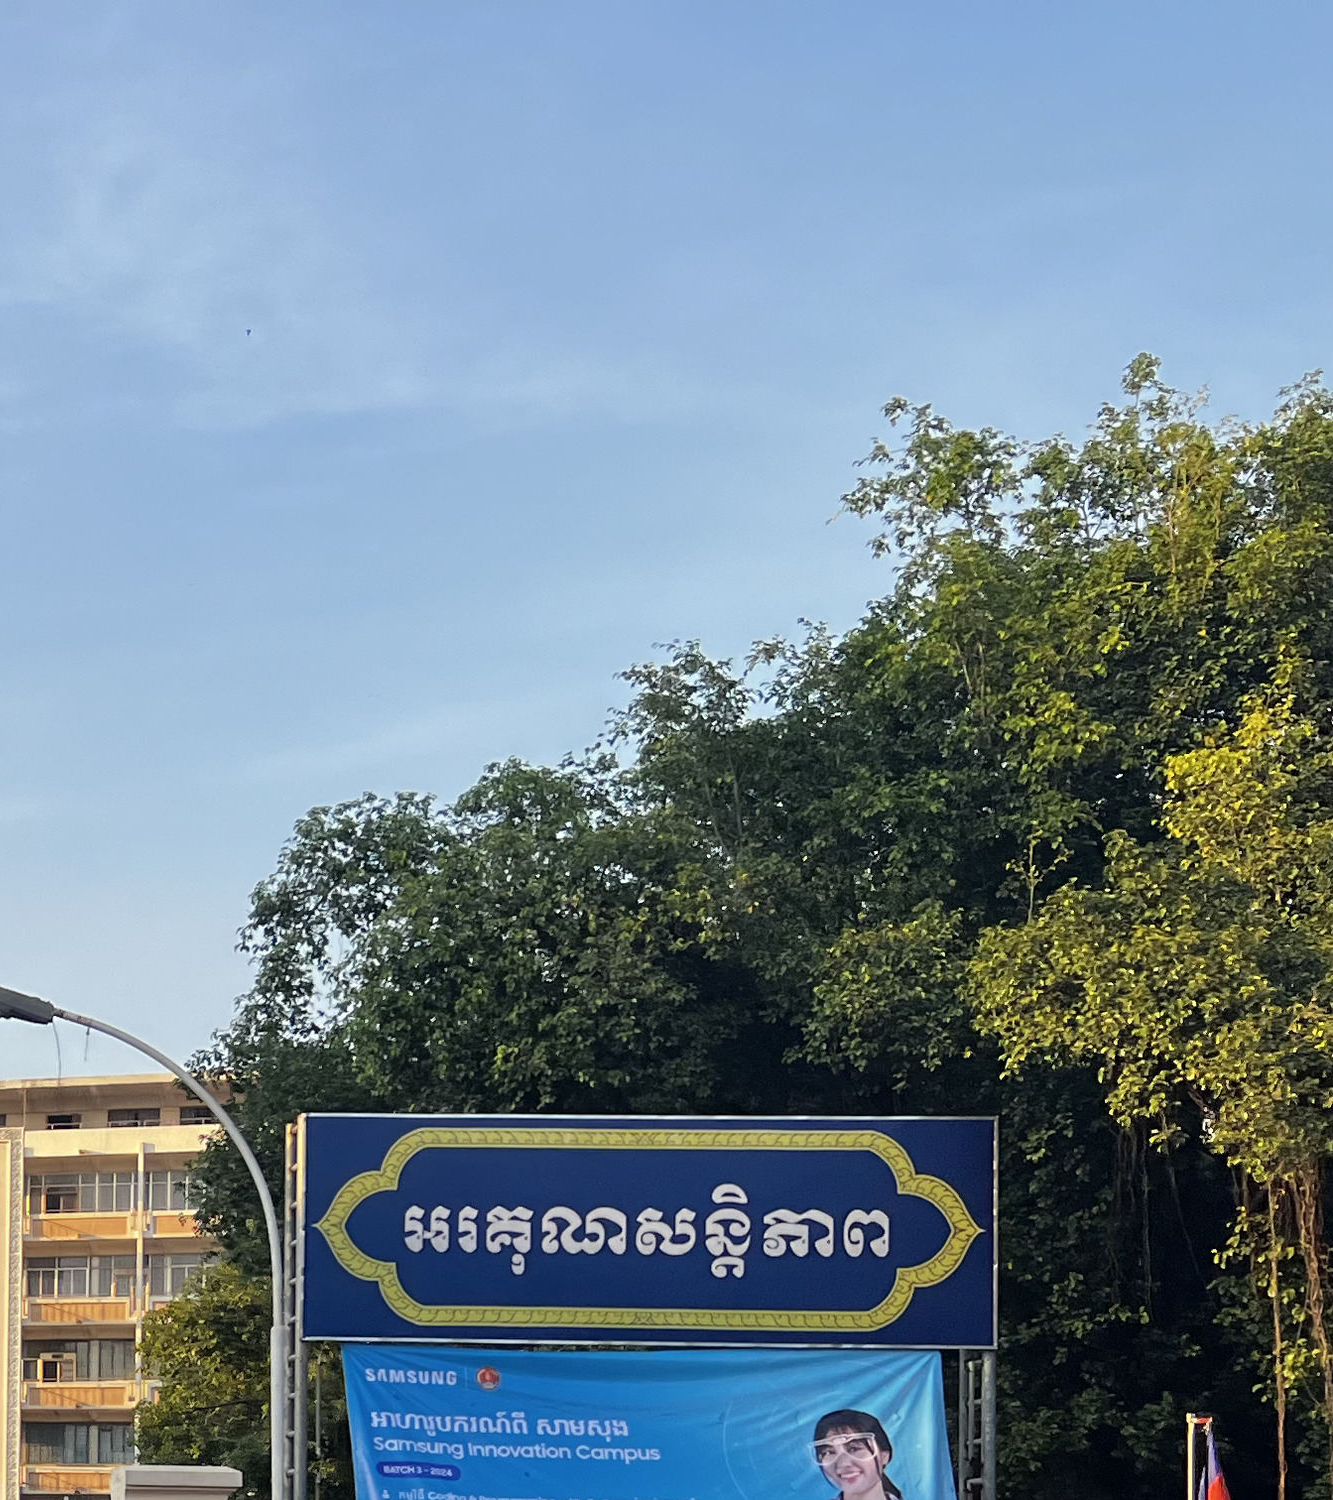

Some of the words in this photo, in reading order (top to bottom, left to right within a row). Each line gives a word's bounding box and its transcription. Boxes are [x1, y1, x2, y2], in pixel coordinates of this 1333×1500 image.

[404, 1182, 891, 1279] អរគុណសន្តិភាព
[365, 1368, 457, 1385] SAMSUNG
[373, 1436, 464, 1460] Samsung
[468, 1442, 571, 1460] Innovation
[575, 1445, 661, 1465] Campus
[383, 1465, 414, 1475] BATCH
